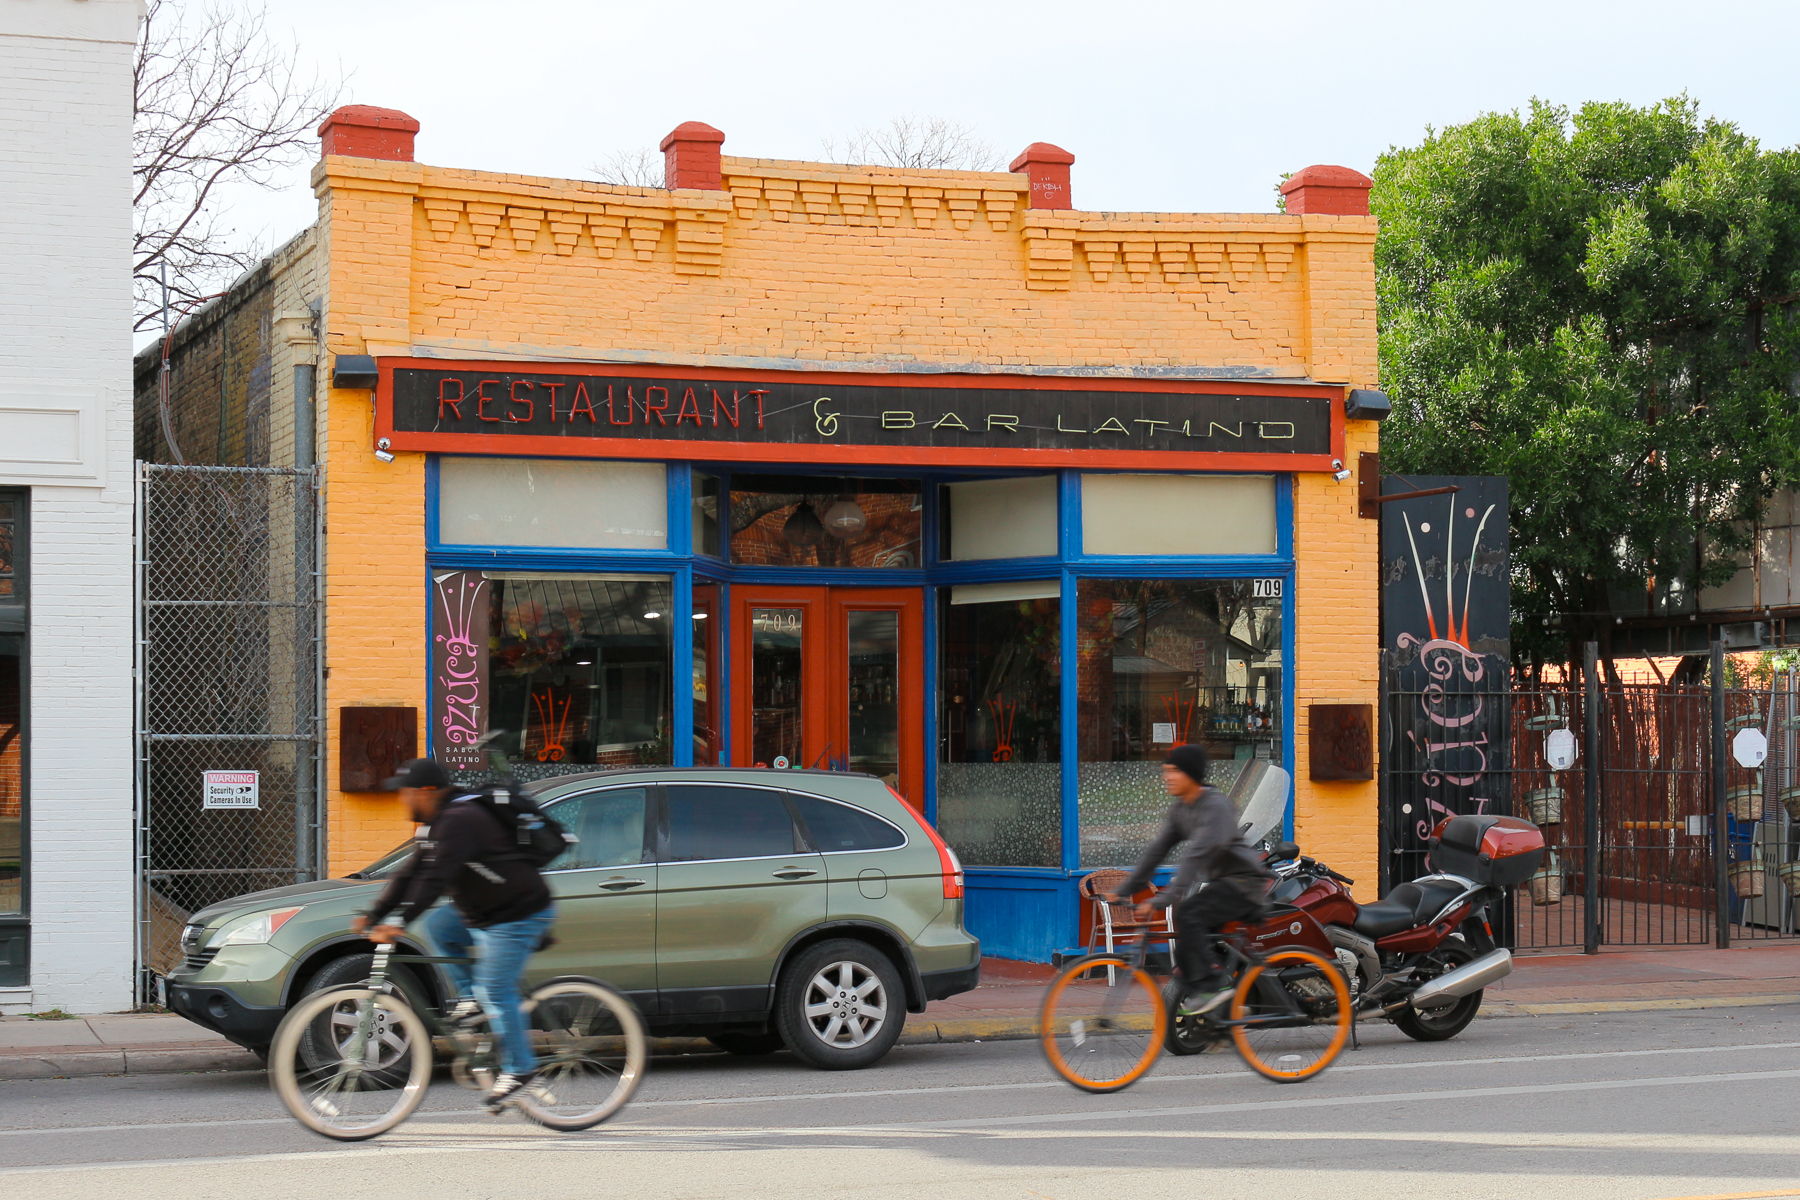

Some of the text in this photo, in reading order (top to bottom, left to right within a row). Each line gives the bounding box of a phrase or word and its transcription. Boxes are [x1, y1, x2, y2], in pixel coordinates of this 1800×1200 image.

[439, 378, 1295, 438] RESTAURANT & BAR LATINO
[1255, 580, 1281, 596] 709
[760, 613, 796, 632] 709
[210, 774, 252, 782] WARNING
[210, 786, 234, 795] Security
[210, 796, 252, 804] Cameras In Use
